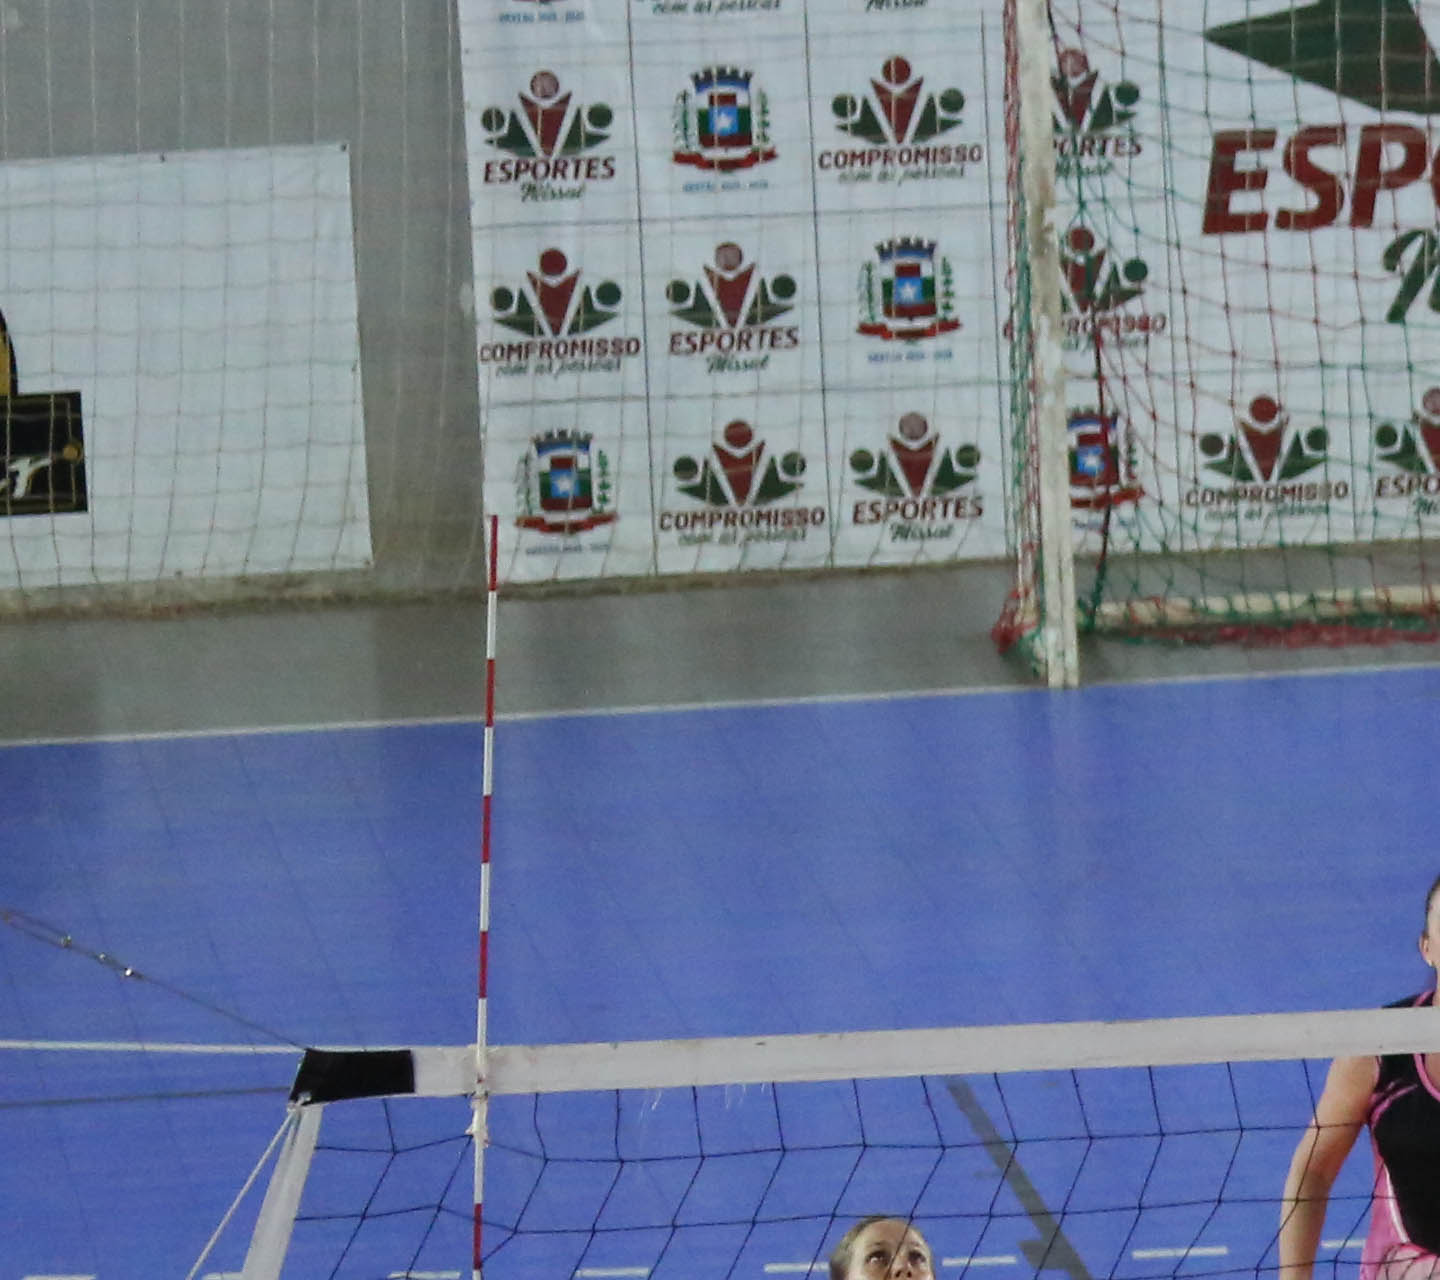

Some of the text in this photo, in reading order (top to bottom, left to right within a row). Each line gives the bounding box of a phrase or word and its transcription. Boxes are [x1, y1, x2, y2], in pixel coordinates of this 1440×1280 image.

[483, 156, 615, 184] ESPORTES
[818, 144, 984, 170] COMPROMISSO
[479, 336, 641, 363] COMPROMISSO
[669, 326, 800, 356] ESPORTES
[660, 505, 825, 532] COMPROMISSO
[852, 497, 984, 525] ESPORTES
